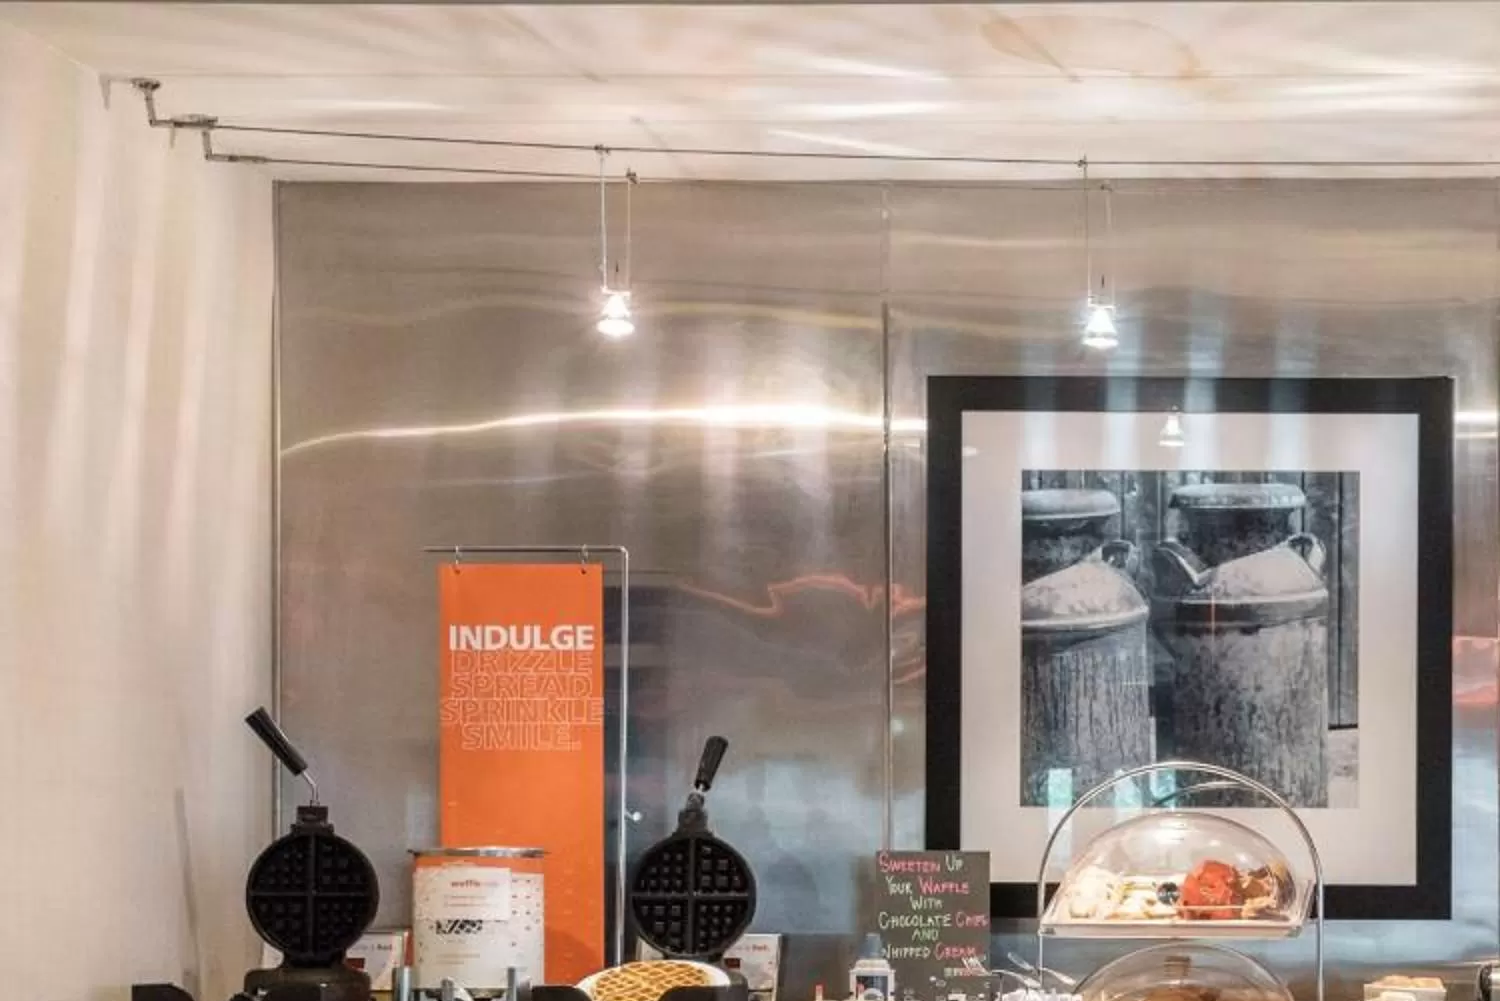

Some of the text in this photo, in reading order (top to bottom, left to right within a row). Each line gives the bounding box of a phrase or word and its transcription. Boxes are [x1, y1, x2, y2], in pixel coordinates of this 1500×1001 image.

[449, 624, 595, 650] INDULGE
[451, 649, 593, 674] DRIZZLE
[449, 672, 593, 701] SPREAD
[440, 697, 604, 725] SPRINKLE
[919, 876, 970, 895] WAFFLE
[878, 911, 952, 930] CHOCOLATE
